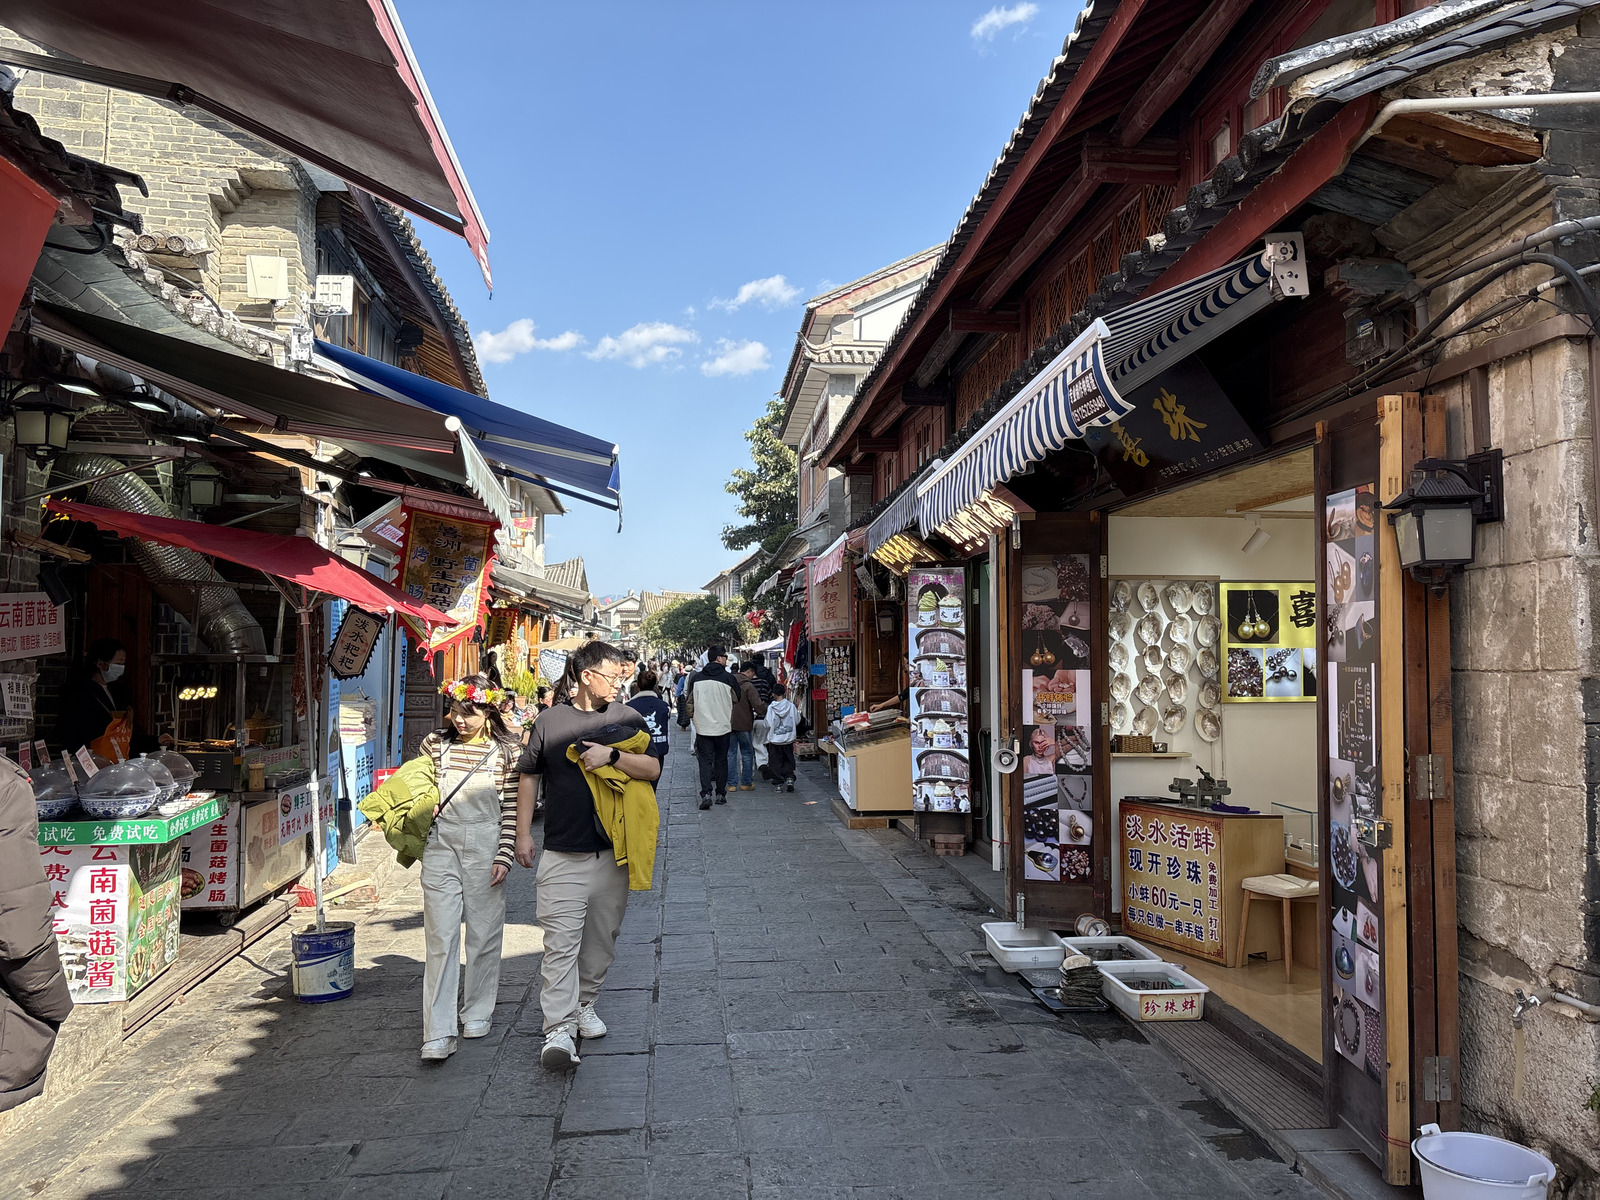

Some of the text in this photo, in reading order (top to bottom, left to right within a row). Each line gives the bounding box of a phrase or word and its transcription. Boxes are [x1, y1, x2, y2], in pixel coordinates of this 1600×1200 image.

[426, 522, 464, 612] 喜洲·野生菌菇
[0, 600, 58, 628] 云南菌菇酱
[820, 576, 841, 620] 张银匠
[1289, 590, 1316, 629] 喜
[37, 823, 159, 843] 试吃 免费试吃
[169, 820, 190, 837] 免费试吃
[190, 806, 209, 827] 免费试吃
[1126, 815, 1216, 856] 淡水活蚌
[208, 808, 229, 902] 生菌菇烤肠
[1128, 848, 1203, 885] 现开珍珠
[88, 845, 119, 989] 云南菌菇酱
[1128, 882, 1204, 918] 小蚌60元一只
[1207, 861, 1219, 941] 免费加工 打孔
[1127, 906, 1205, 942] 每只包做一串手链
[1144, 995, 1197, 1017] 珍珠蚌
